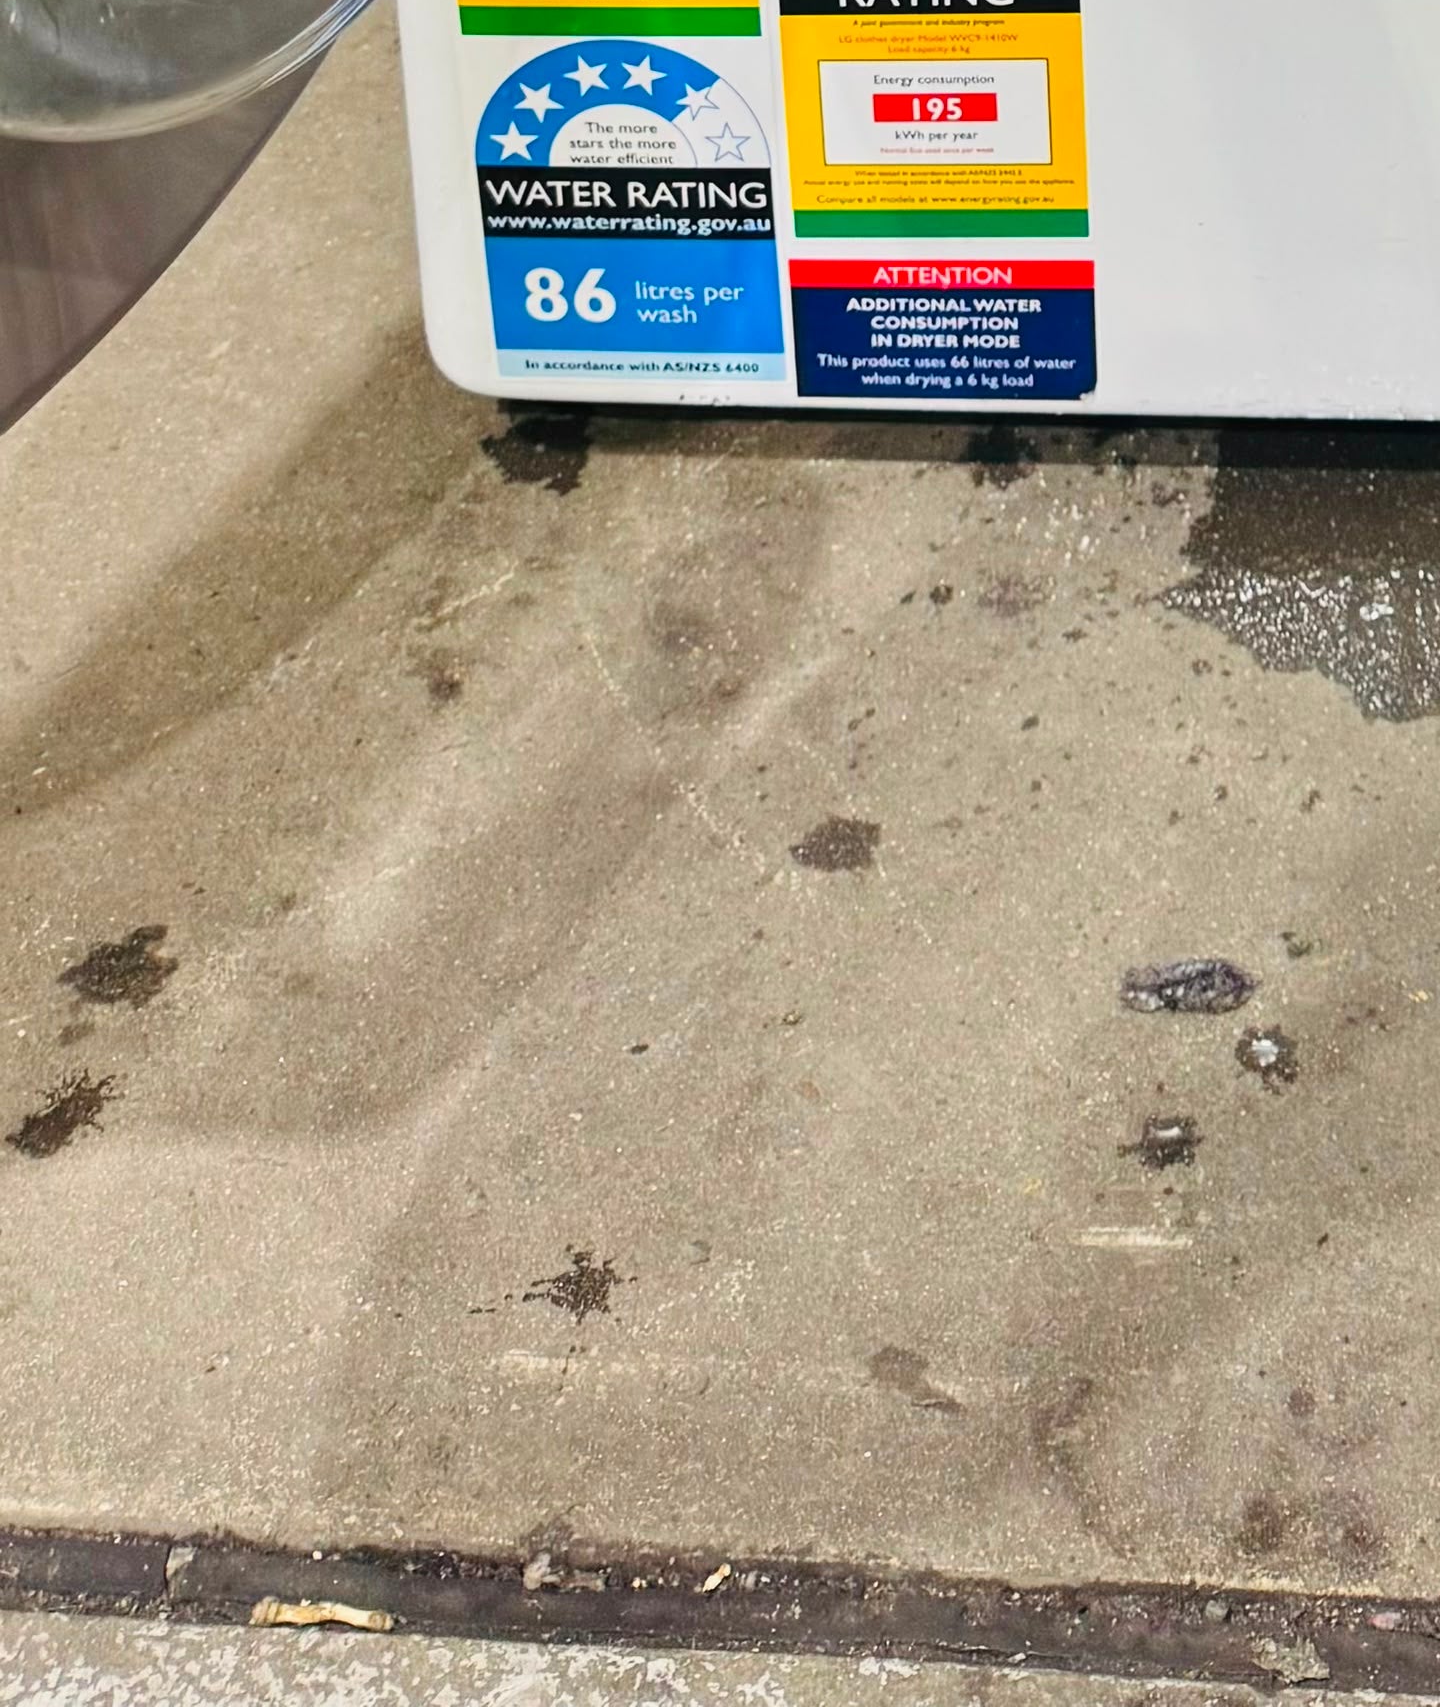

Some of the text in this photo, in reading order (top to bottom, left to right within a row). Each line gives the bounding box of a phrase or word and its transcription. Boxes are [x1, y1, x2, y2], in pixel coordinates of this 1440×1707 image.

[873, 74, 995, 86] Energy consumption
[912, 97, 963, 121] 195
[586, 122, 657, 134] The more
[569, 138, 676, 149] stars the more
[895, 130, 979, 142] kWh per year
[570, 154, 674, 165] water efficient
[485, 179, 768, 209] WATER RATING
[488, 214, 771, 236] www.waterrating.gov.au
[873, 267, 1013, 285] ATTENTION
[524, 267, 617, 323] 86
[635, 281, 744, 306] litres per
[846, 298, 1041, 313] ADDITIONAL WATER
[636, 305, 697, 324] wash
[870, 316, 1018, 331] CONSUMPTION
[871, 334, 1020, 349] IN DRYER MODE
[526, 359, 759, 373] In accordance with AS/NZS 6400
[817, 353, 1076, 370] This product uses 66 litres of water
[861, 373, 1033, 389] when drying a 6 kg load
